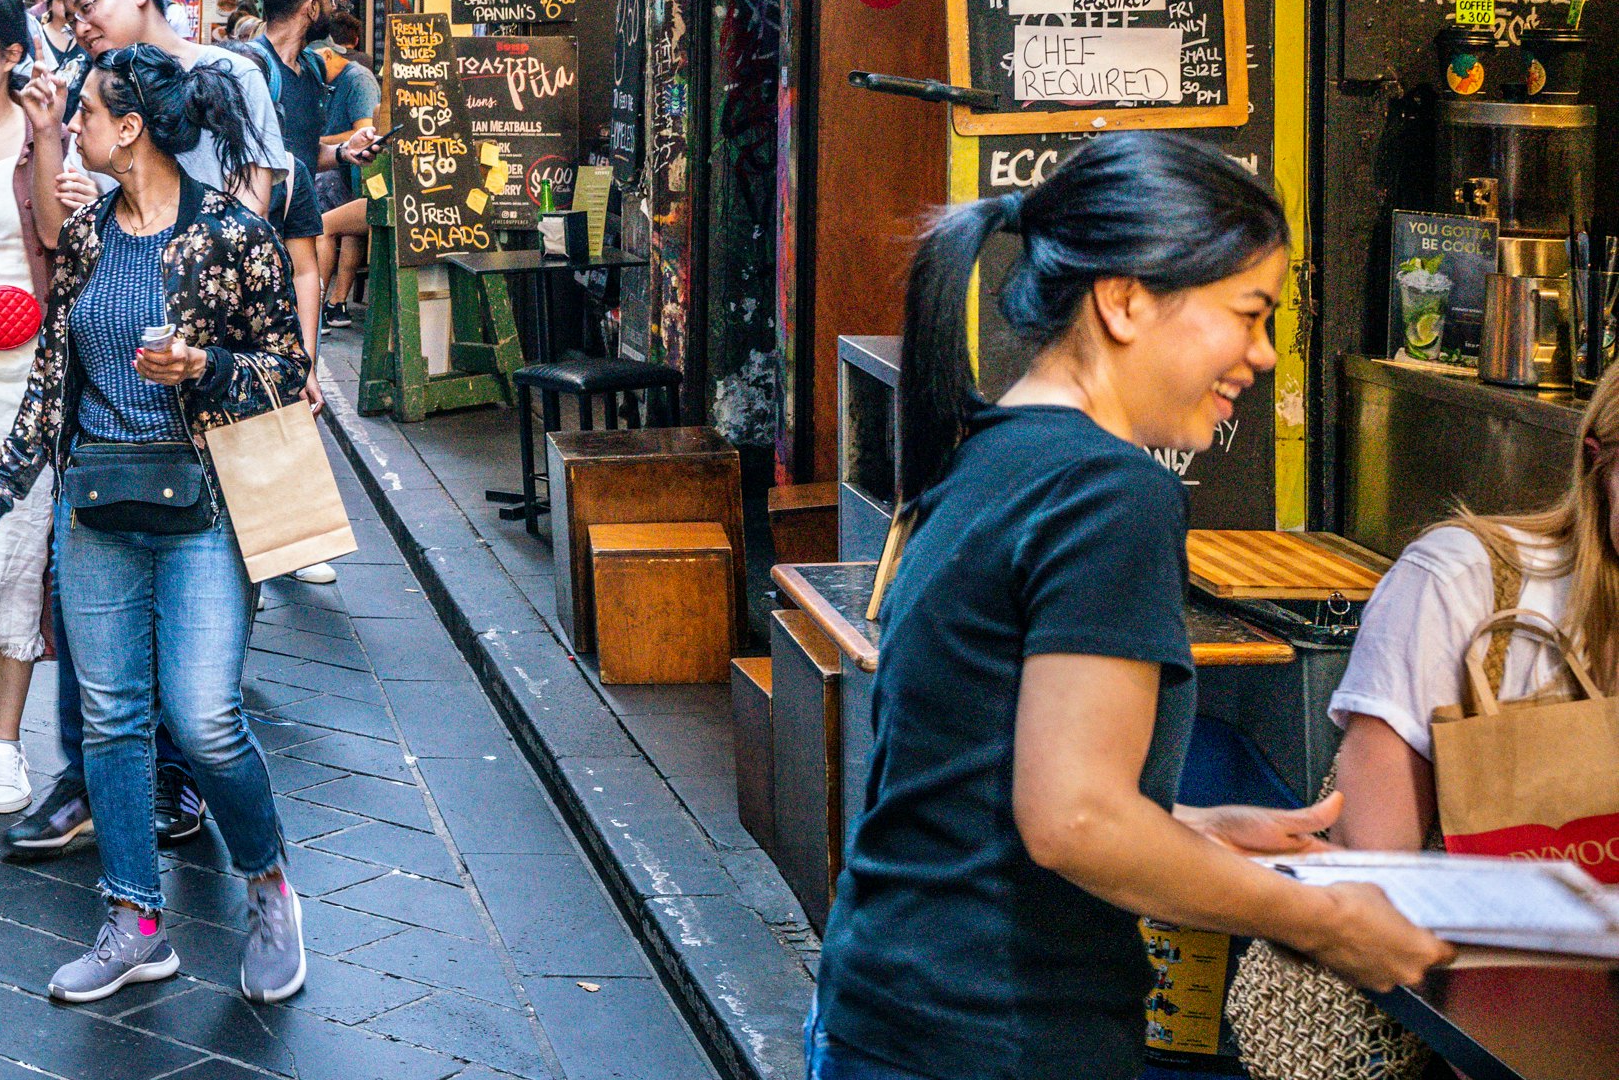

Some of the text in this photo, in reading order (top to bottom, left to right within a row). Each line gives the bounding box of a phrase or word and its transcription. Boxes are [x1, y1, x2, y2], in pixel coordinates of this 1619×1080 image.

[1168, 2, 1192, 20] FRI
[1459, 0, 1493, 11] COFFEE
[391, 17, 435, 37] FRESHLY
[395, 31, 444, 48] SQUEEZED
[399, 45, 437, 60] JUICES
[1023, 34, 1103, 69] CHEF
[392, 60, 451, 80] BREAKFAST
[456, 56, 541, 75] TOASTED
[1182, 66, 1222, 78] SIZE
[1022, 67, 1169, 100] REQUIRED
[489, 119, 542, 133] MEATBALLS
[397, 137, 468, 159] BAGUETTES
[403, 194, 462, 227] 8 FRESH
[409, 223, 490, 253] SALADS
[1408, 221, 1492, 240] YOU GOTTA
[1422, 237, 1439, 251] BE
